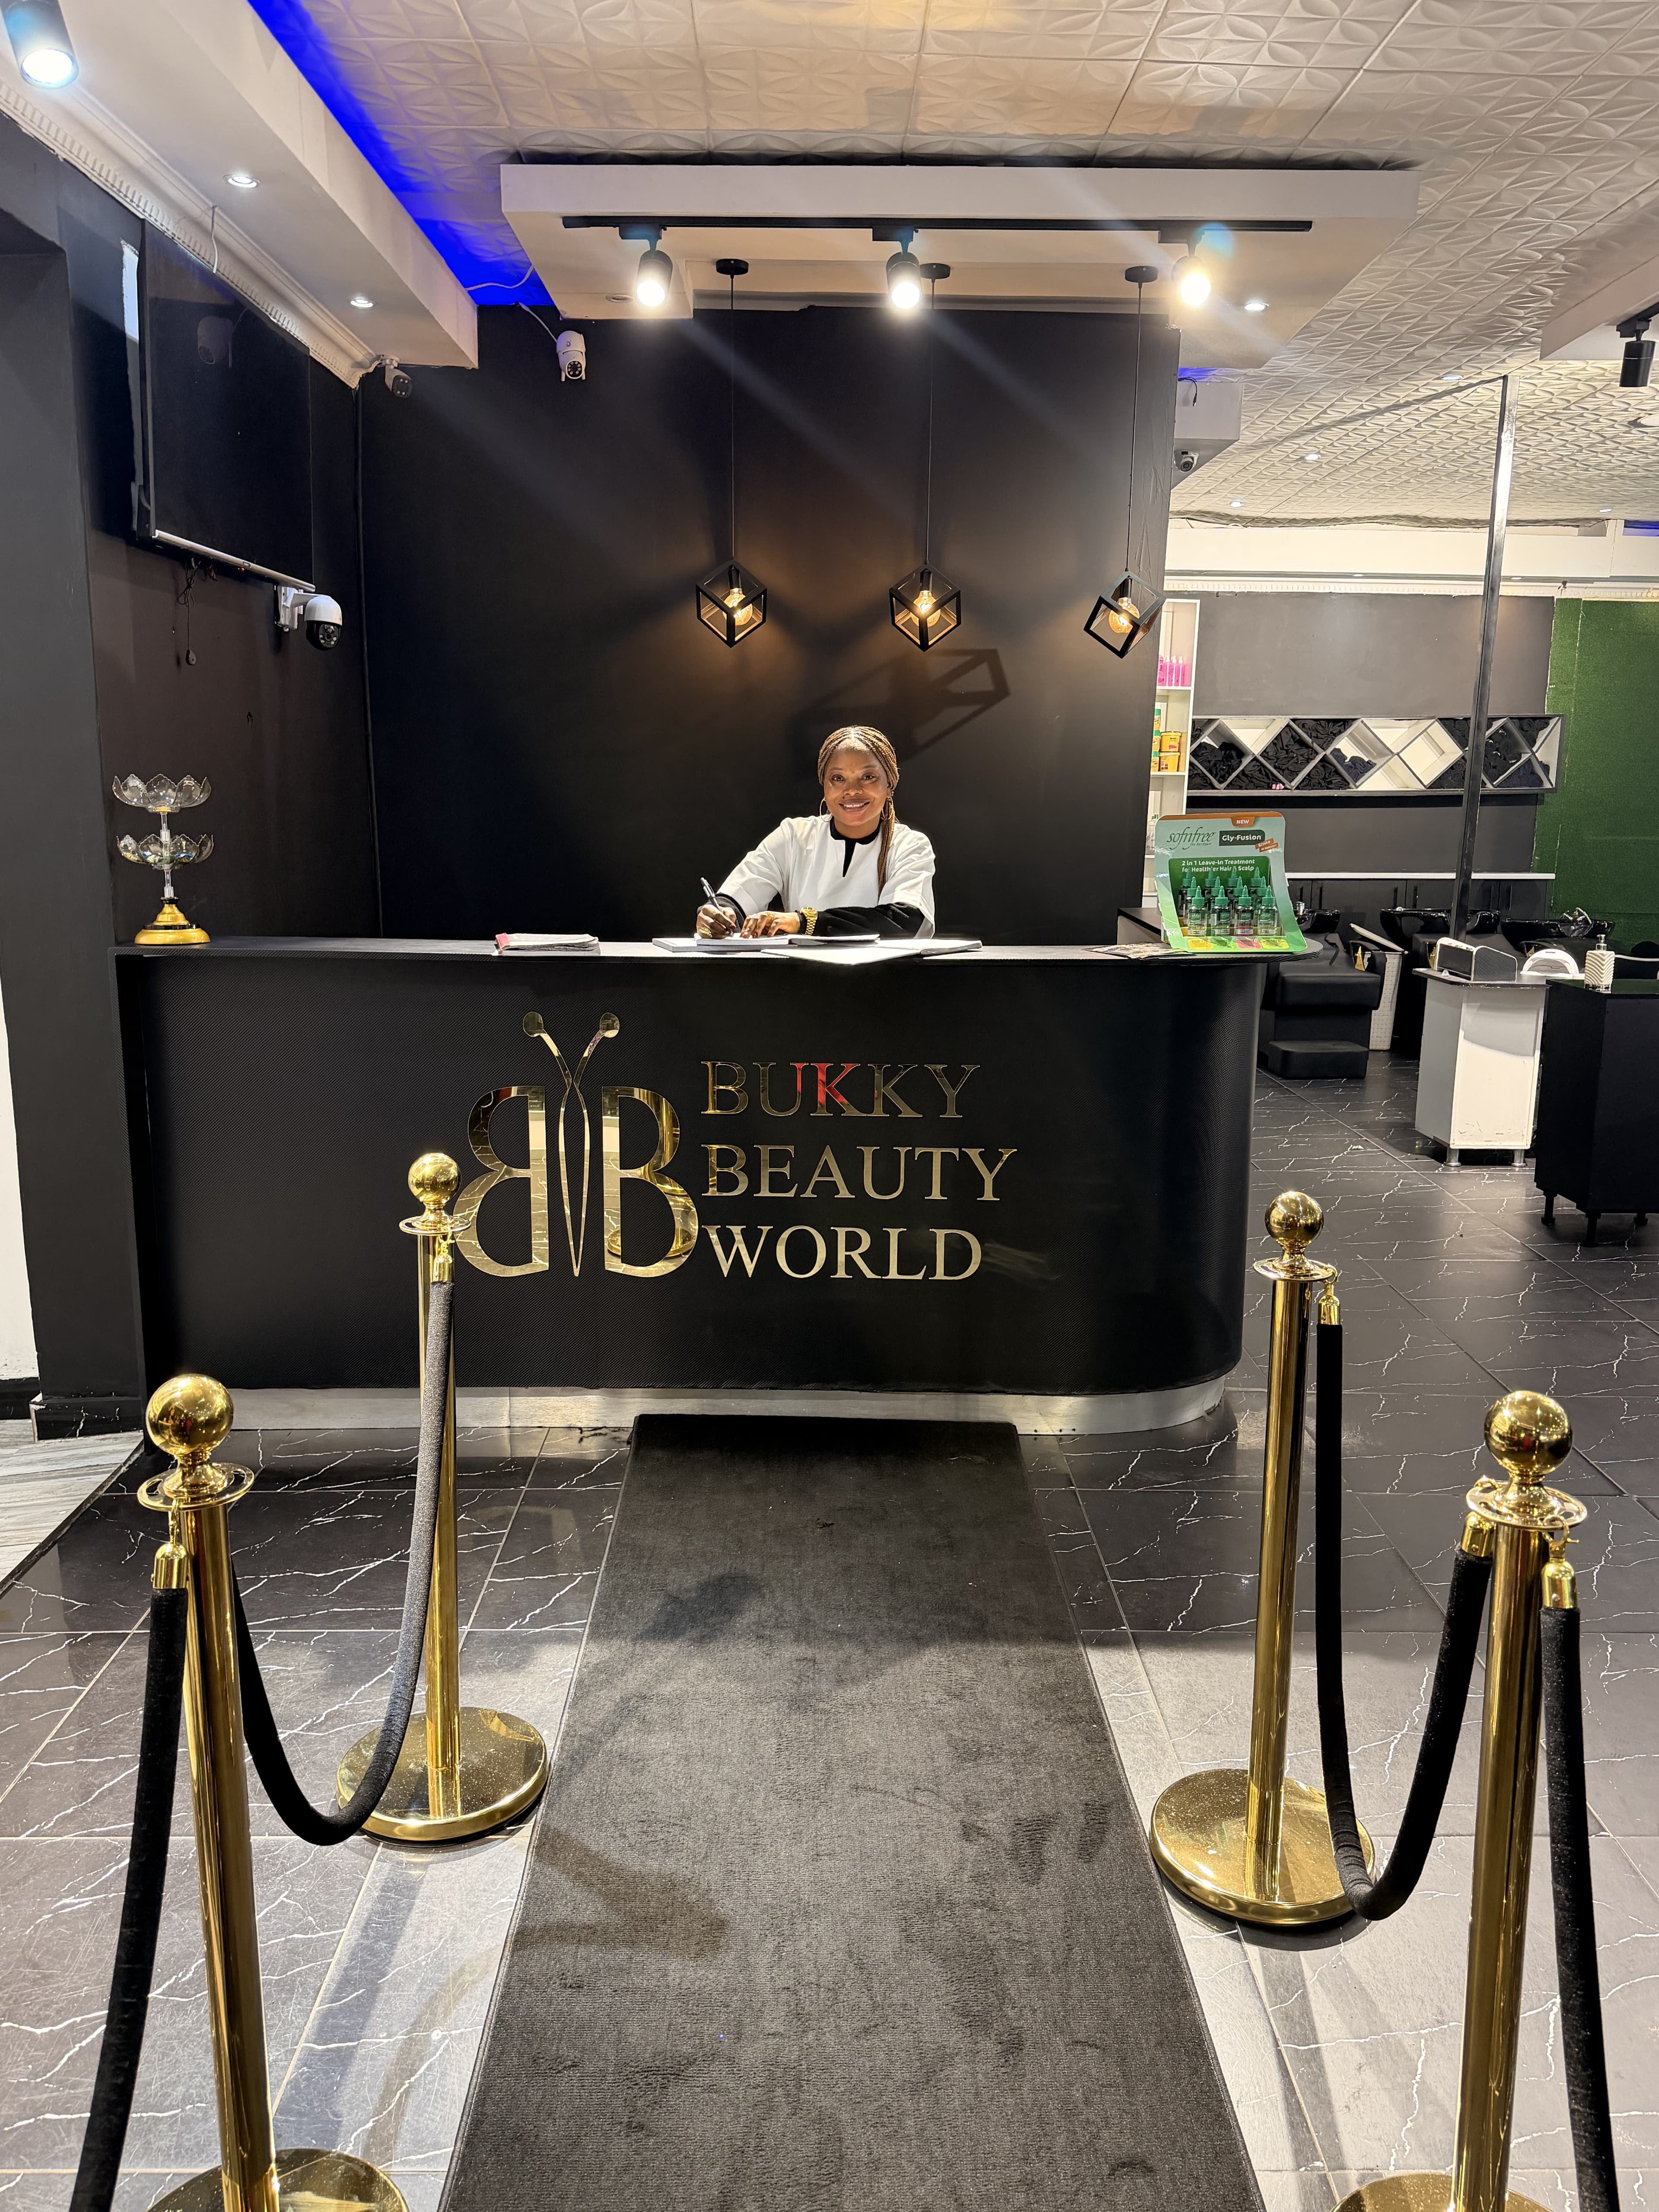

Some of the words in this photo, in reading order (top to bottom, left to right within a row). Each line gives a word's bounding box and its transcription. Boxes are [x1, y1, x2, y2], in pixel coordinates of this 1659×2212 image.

[1222, 834, 1262, 842] Gly-Fusion
[700, 1060, 981, 1118] BUKKY
[700, 1144, 1018, 1201] BEAUTY
[701, 1225, 982, 1281] WORLD
